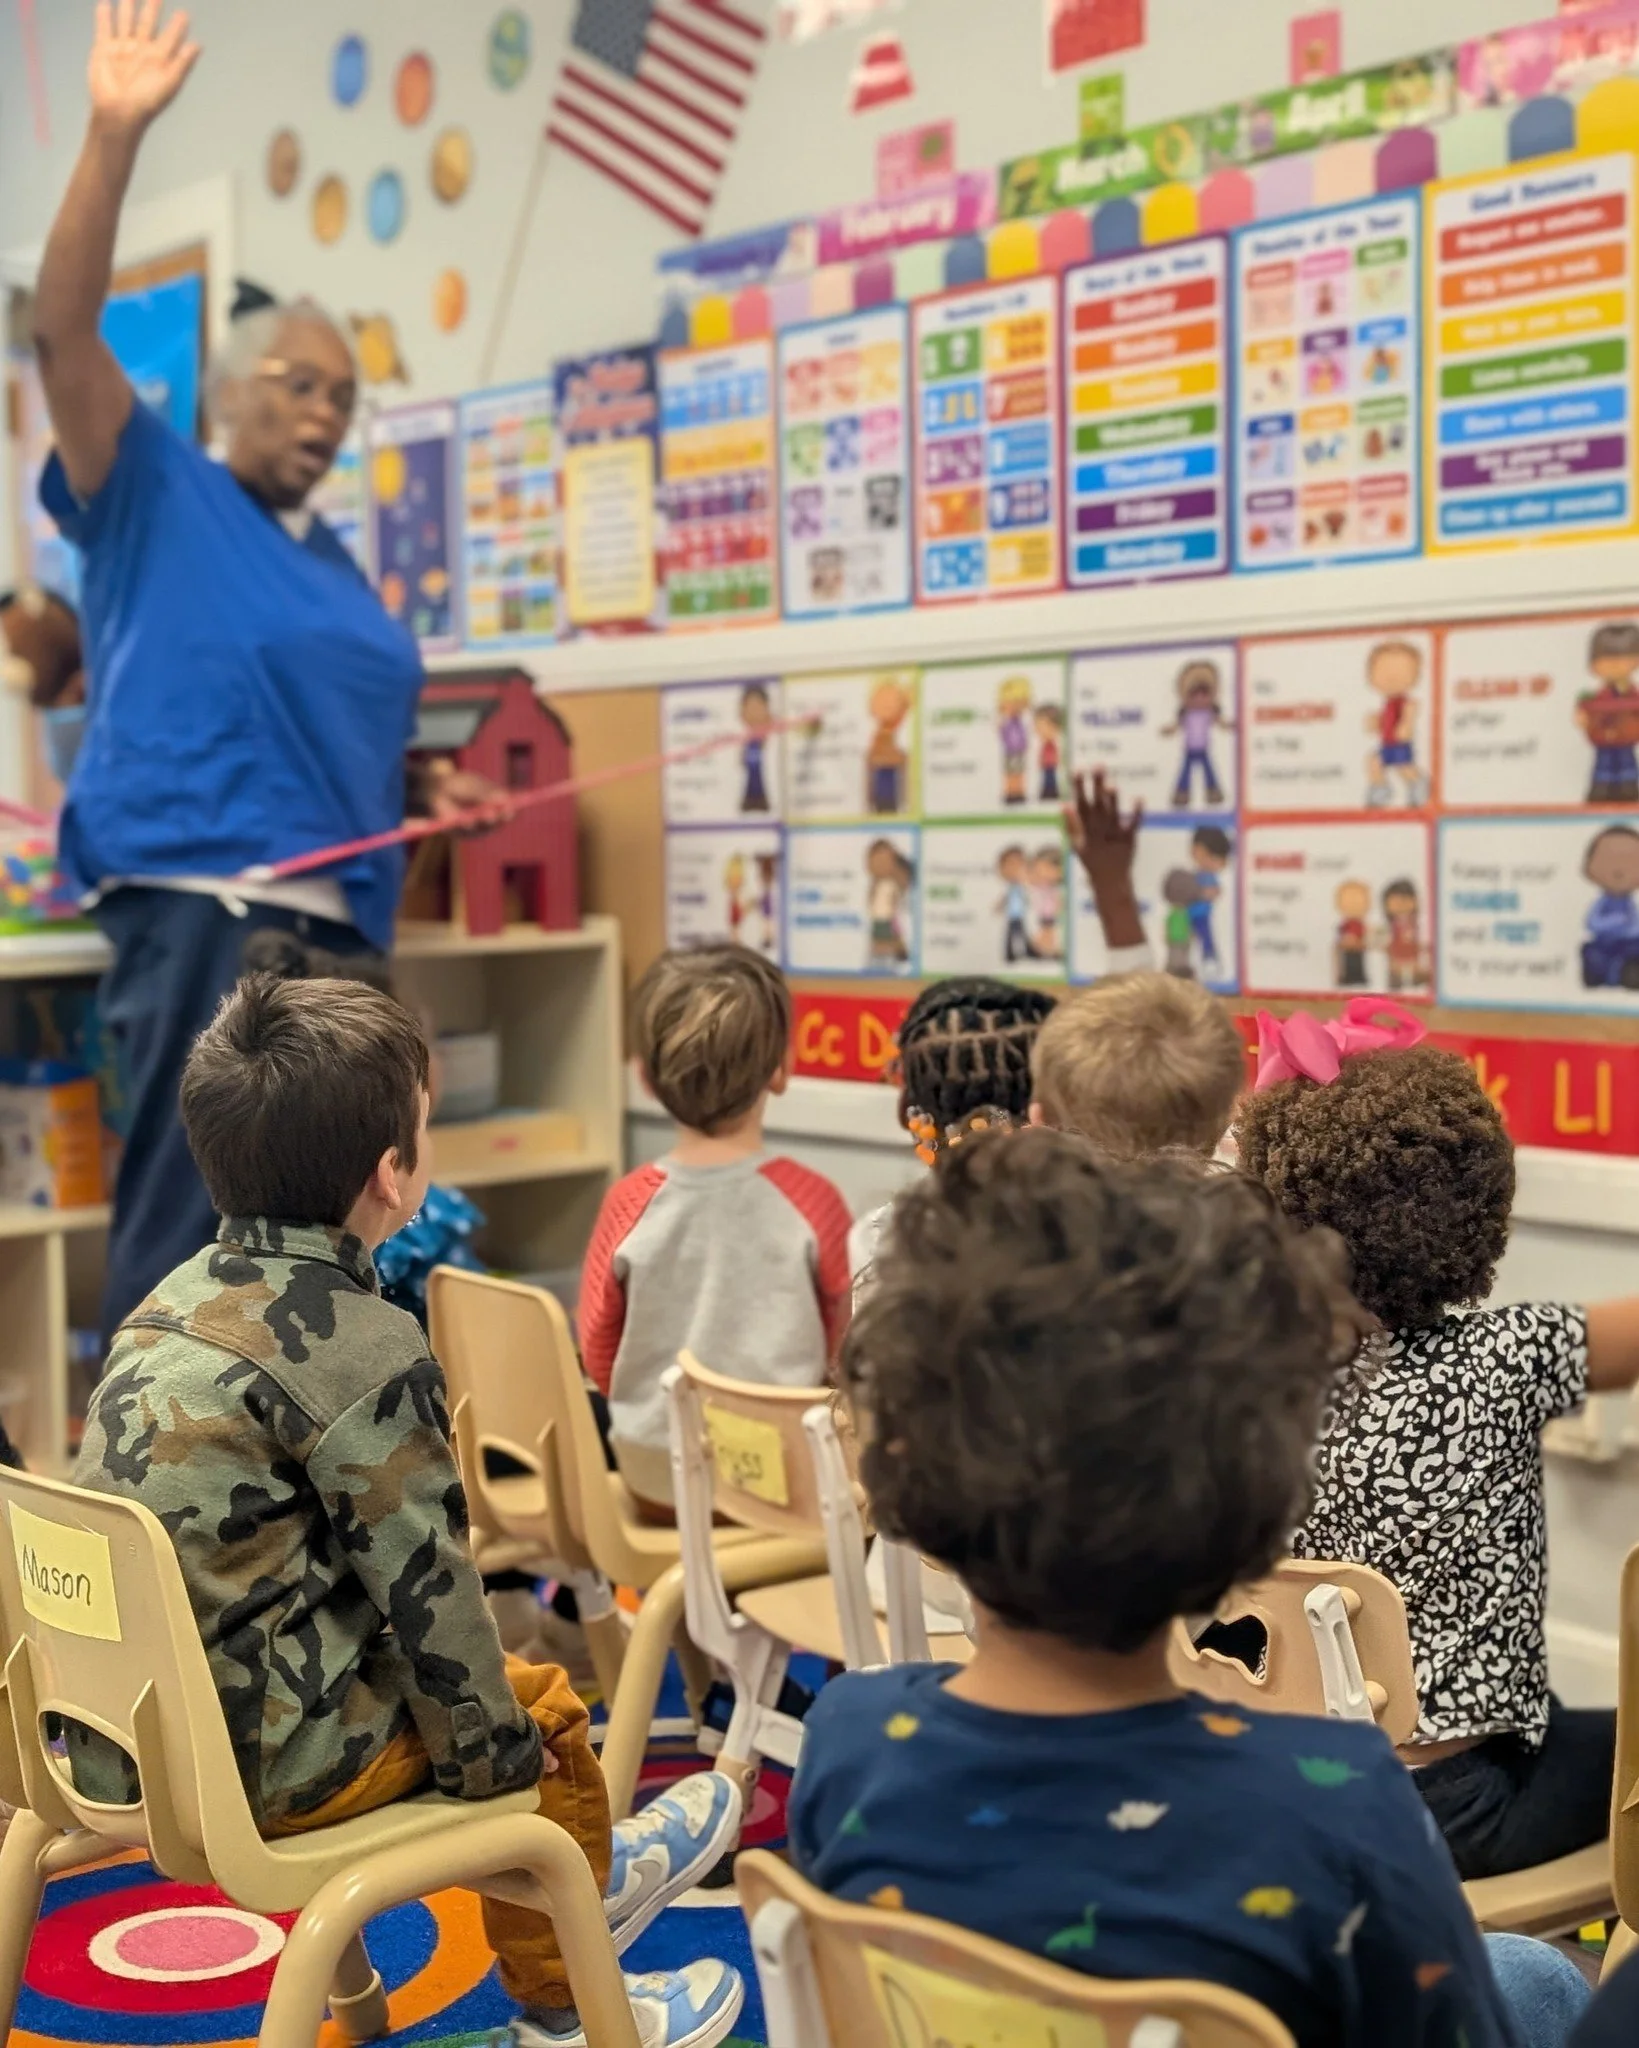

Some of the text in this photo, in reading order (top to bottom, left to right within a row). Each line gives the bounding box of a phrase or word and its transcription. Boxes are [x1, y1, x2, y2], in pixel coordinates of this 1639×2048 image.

[1057, 144, 1149, 192] March
[798, 1009, 845, 1068] Cc
[22, 1544, 91, 1606] Mason
